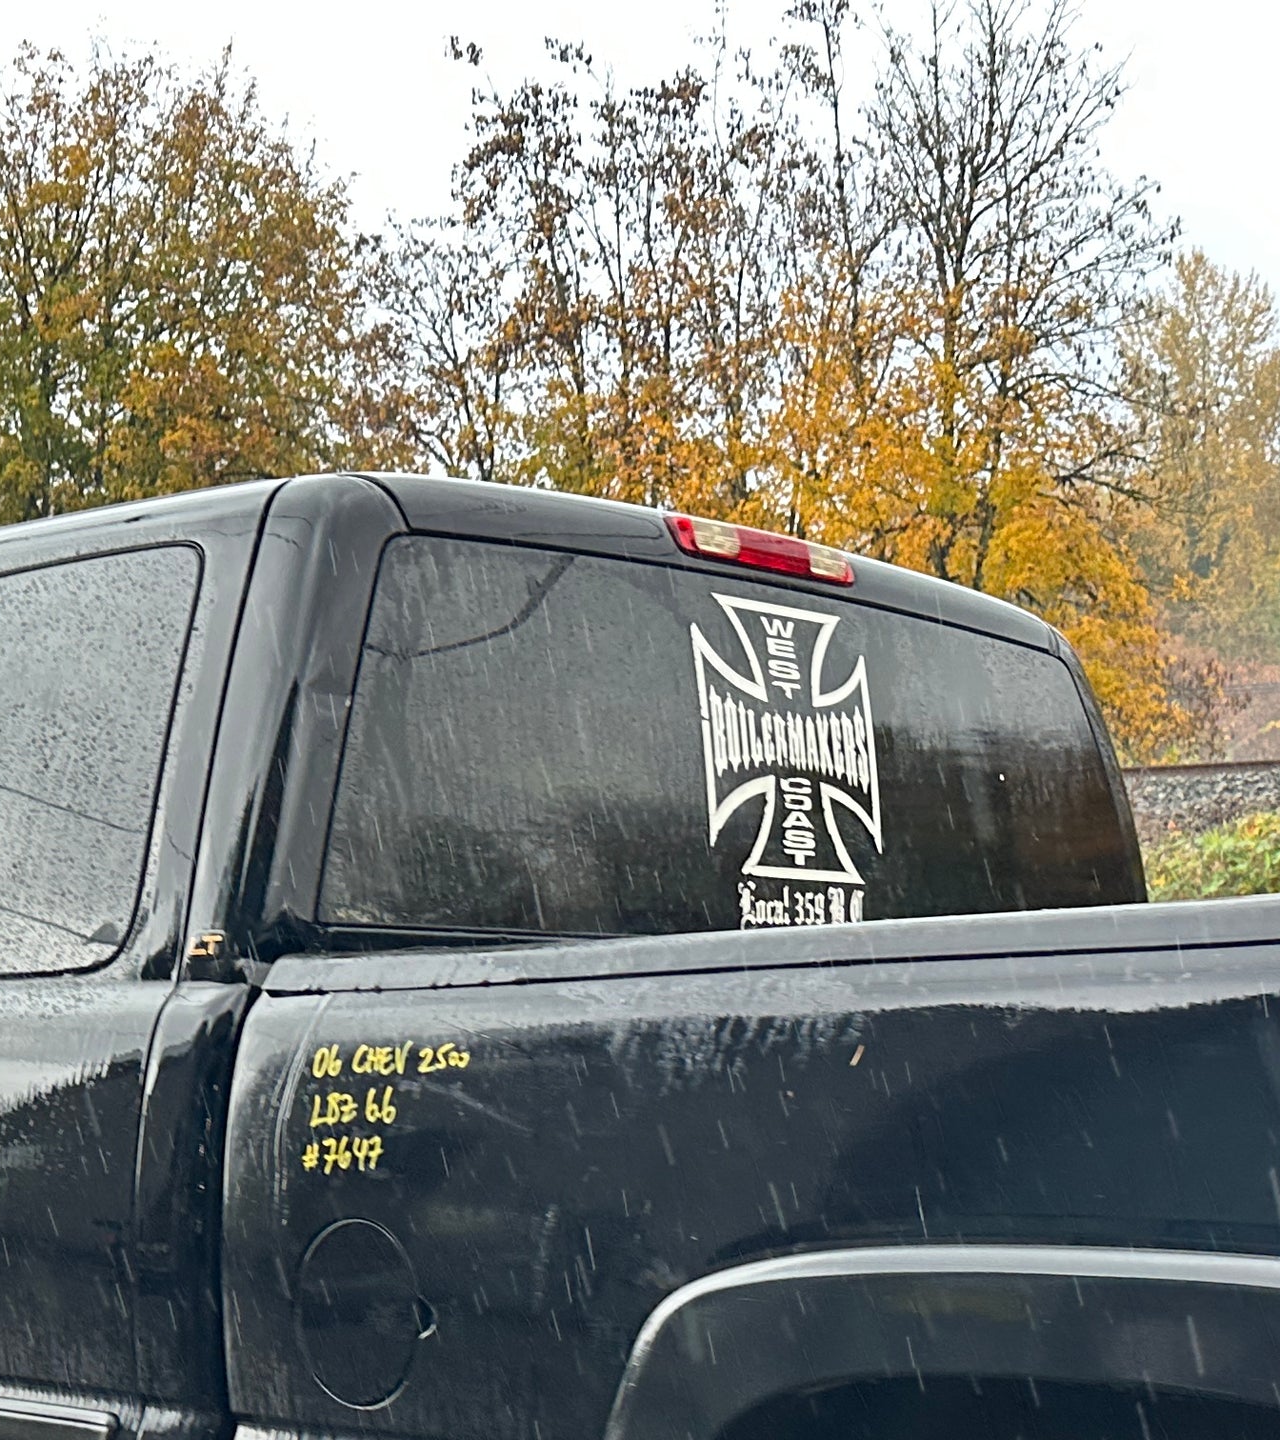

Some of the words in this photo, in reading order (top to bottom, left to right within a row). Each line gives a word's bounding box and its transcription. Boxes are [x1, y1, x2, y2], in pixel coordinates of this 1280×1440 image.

[760, 616, 801, 699] WEST
[709, 684, 869, 794] BOILERMAKERS
[780, 777, 816, 866] COAST
[738, 880, 791, 931] Local
[794, 891, 825, 925] 359
[188, 934, 223, 956] LT
[312, 1043, 342, 1079] 06
[351, 1039, 414, 1076] CHEV
[417, 1042, 470, 1074] 2500
[302, 1135, 384, 1176] #7647
